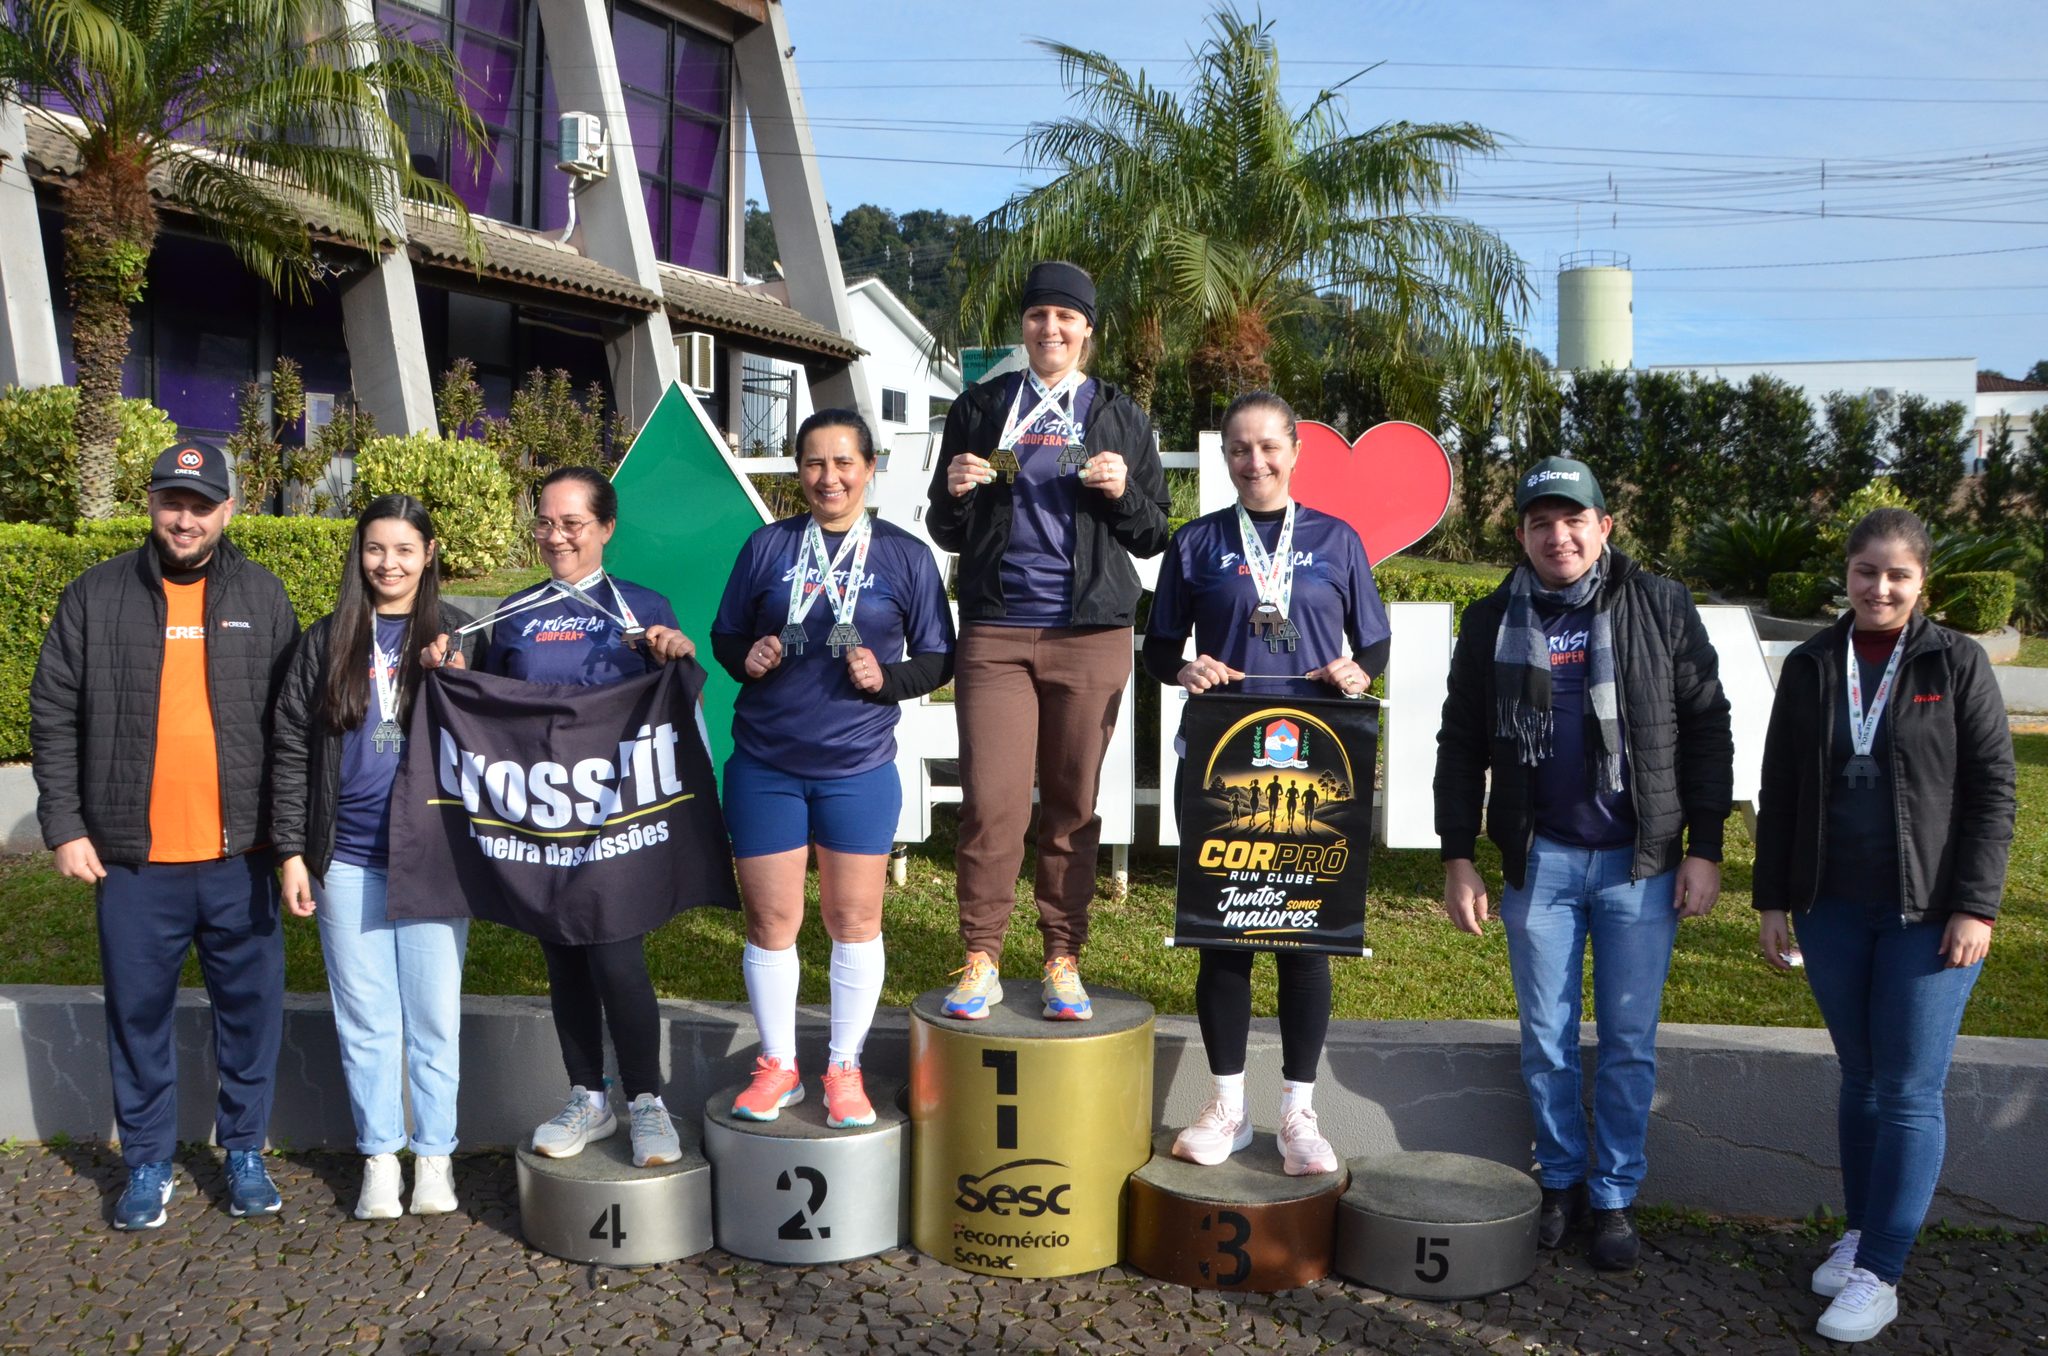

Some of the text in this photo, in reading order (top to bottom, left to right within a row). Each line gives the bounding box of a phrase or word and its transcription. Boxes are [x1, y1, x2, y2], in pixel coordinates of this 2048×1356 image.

[174, 468, 202, 477] CRESOL
[1538, 470, 1580, 482] Sicredi
[229, 621, 251, 629] CRESOL
[542, 615, 606, 634] RÚSTICA
[1549, 650, 1585, 666] OOPER
[1198, 838, 1348, 874] CORPRÓ
[1230, 871, 1315, 885] RUN CLUBE
[1217, 885, 1322, 911] Juntos somos
[1223, 906, 1319, 929] maiores.
[1234, 937, 1301, 948] VICENTE DUTRA
[981, 1048, 1018, 1150] 1
[776, 1166, 831, 1240] 2
[954, 1170, 1071, 1217] Sesc
[589, 1203, 627, 1248] 4
[1199, 1210, 1252, 1286] 3
[1414, 1236, 1450, 1283] 5
